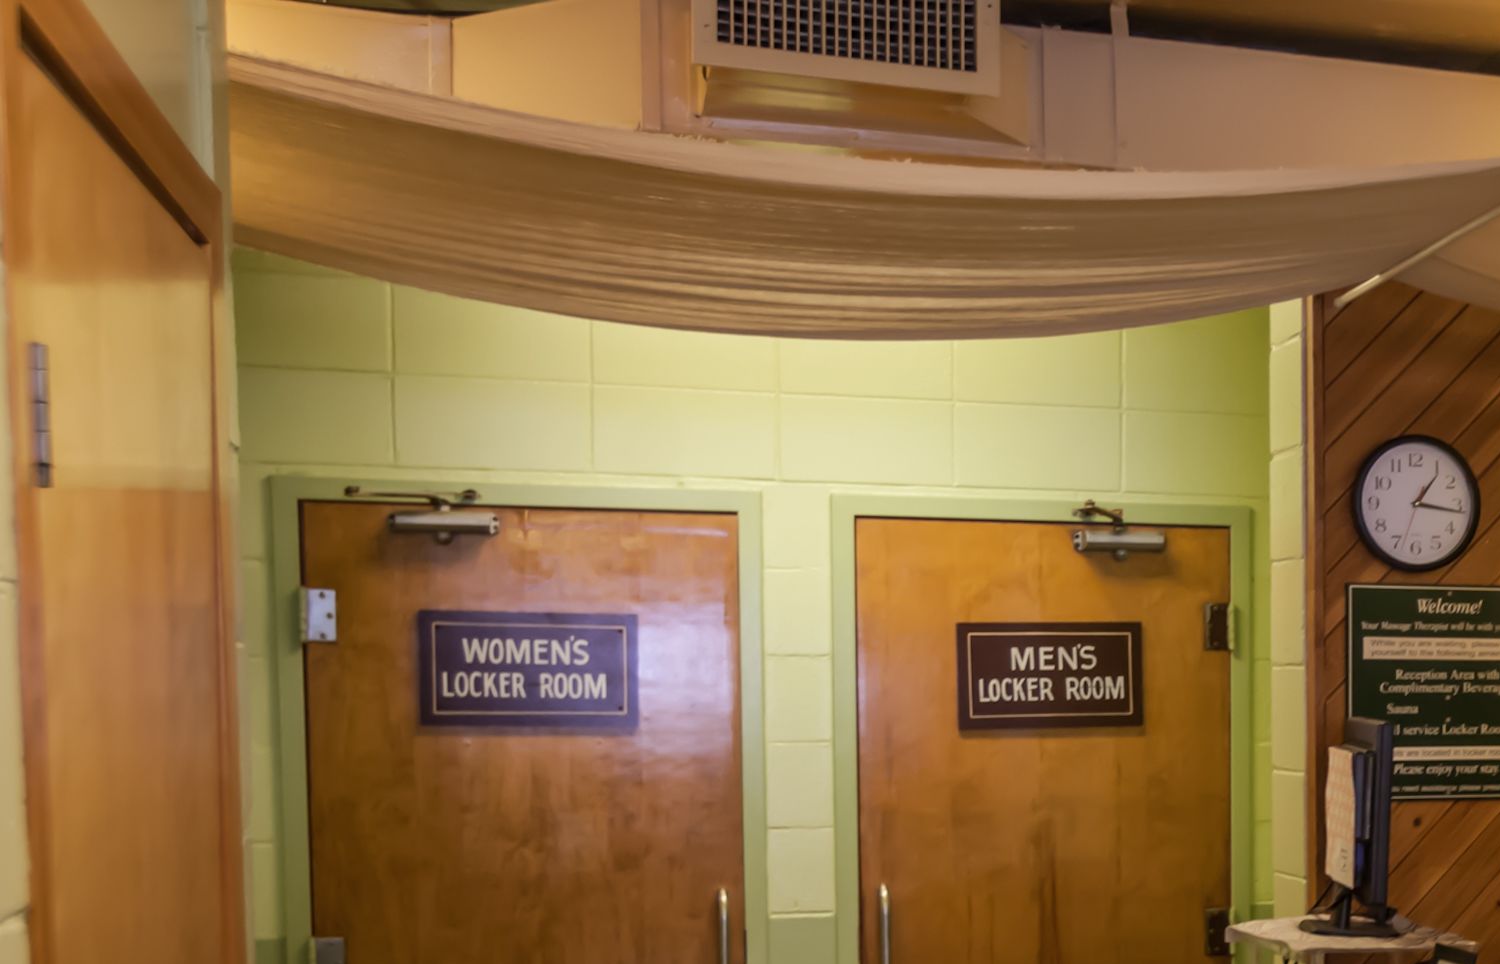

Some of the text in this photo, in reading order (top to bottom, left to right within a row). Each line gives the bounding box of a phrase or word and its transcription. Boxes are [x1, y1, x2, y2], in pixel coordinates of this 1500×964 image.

[1390, 458, 1402, 473] 11
[1408, 452, 1424, 468] 12
[1374, 476, 1392, 491] 10
[1445, 475, 1456, 490] 2
[1367, 496, 1380, 511] 9
[1450, 497, 1463, 513] 3
[1374, 518, 1387, 533] 8
[1444, 521, 1455, 535] 4
[1391, 535, 1402, 549] 7
[1410, 541, 1422, 556] 6
[1430, 535, 1442, 550] 5
[1416, 598, 1484, 615] Welcome!
[1414, 621, 1449, 633] Therapist
[1450, 621, 1464, 631] will
[1465, 621, 1475, 632] be
[1476, 622, 1494, 632] with
[461, 635, 591, 666] WOMEN'S
[1398, 641, 1416, 649] you
[1010, 643, 1098, 672] MEN'S
[1395, 668, 1500, 683] Reception Area with
[441, 671, 608, 700] LOCKER ROOM
[978, 675, 1126, 703] LOCKER ROOM
[1379, 681, 1461, 696] Complimentary
[1386, 703, 1419, 715] Sauna
[1402, 724, 1440, 736] service
[1441, 723, 1479, 736] Locker
[1393, 763, 1424, 776] Please
[1425, 763, 1454, 777] enjoy
[1454, 765, 1480, 777] your
